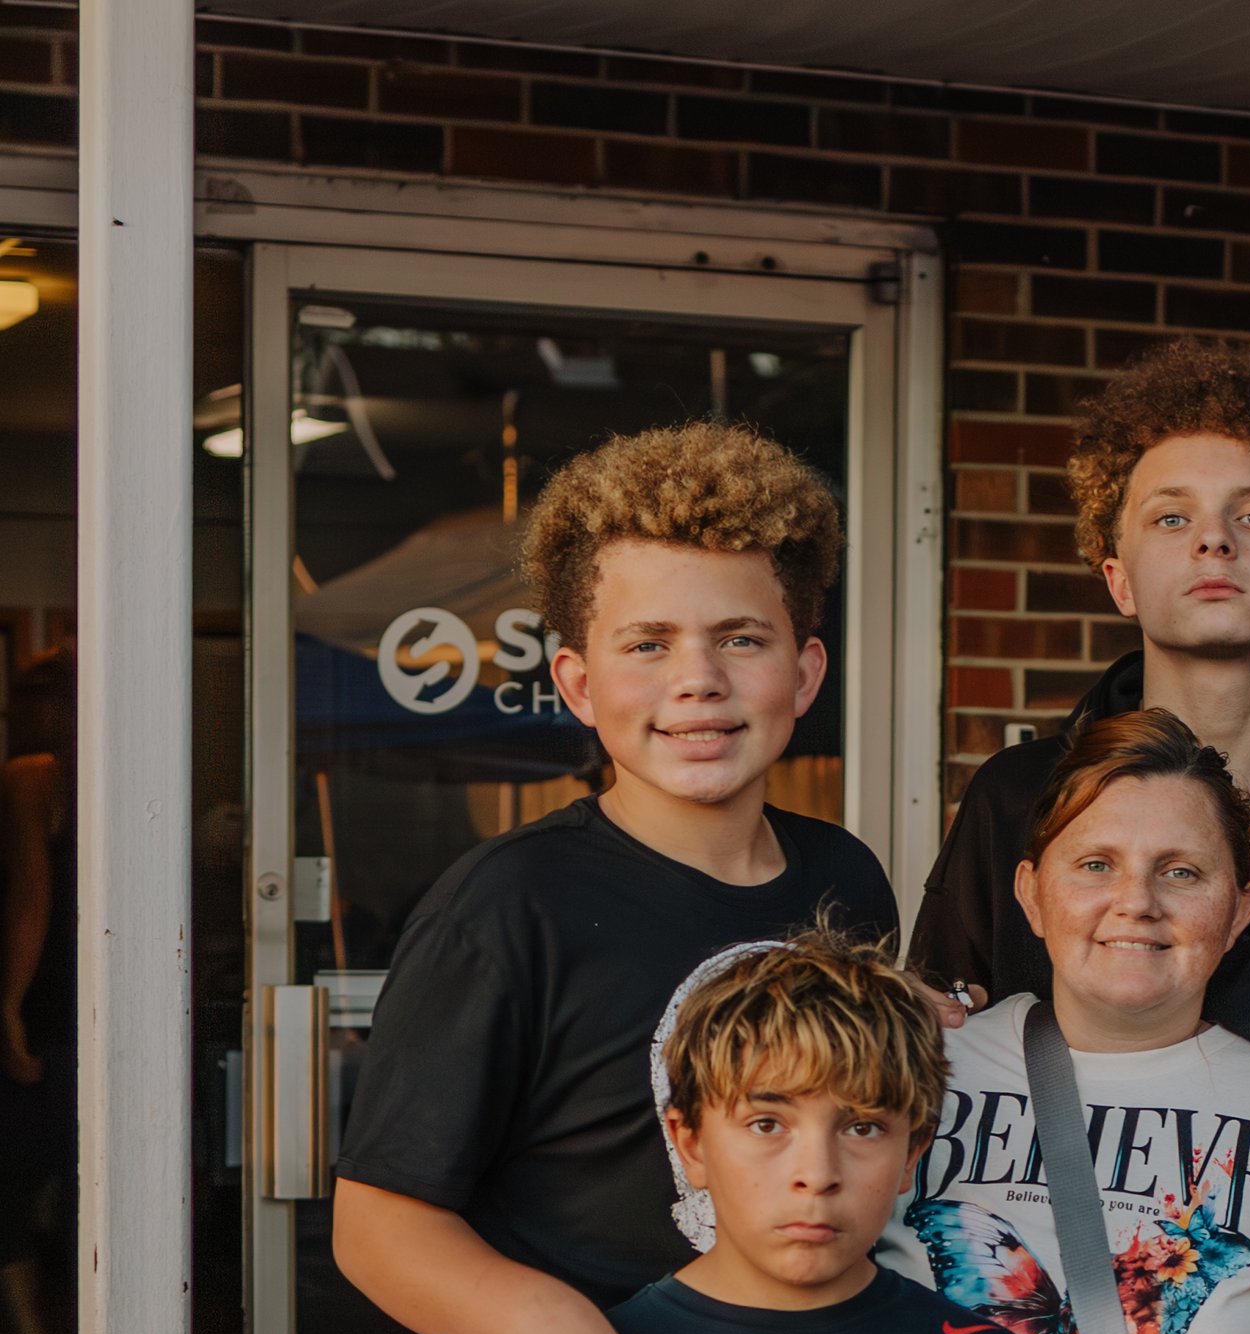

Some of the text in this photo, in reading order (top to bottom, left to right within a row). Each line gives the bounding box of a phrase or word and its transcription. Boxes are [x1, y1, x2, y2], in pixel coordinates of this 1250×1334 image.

[1006, 1190, 1052, 1206] Believ
[1109, 1199, 1134, 1212] you
[1138, 1206, 1160, 1217] are
